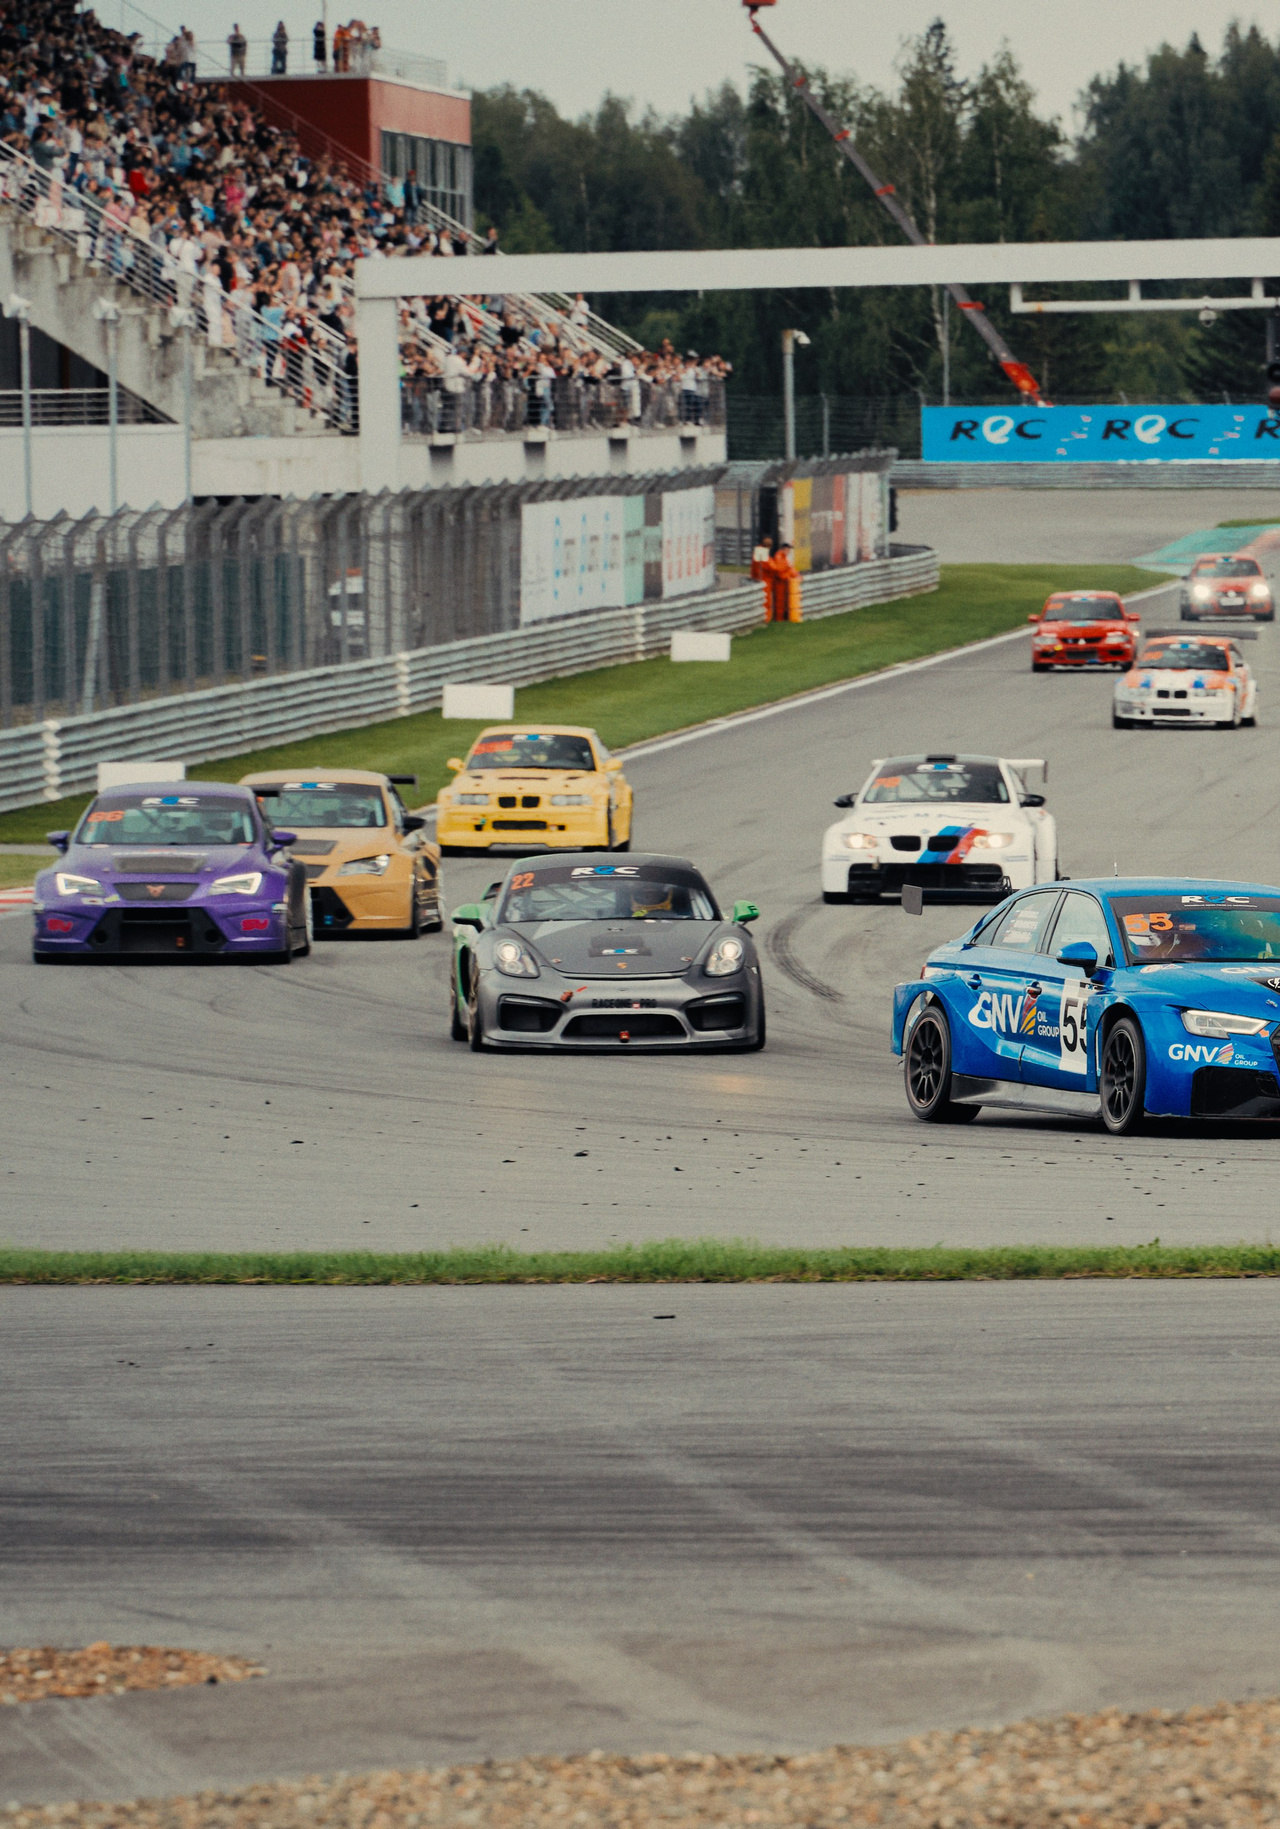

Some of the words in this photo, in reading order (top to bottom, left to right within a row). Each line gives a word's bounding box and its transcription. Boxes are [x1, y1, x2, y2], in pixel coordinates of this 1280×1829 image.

[511, 872, 535, 890] 22
[1123, 912, 1174, 933] 55
[1037, 1011, 1048, 1023] OIL
[1037, 1025, 1060, 1038] GROUP
[1168, 1043, 1220, 1063] GNV
[1234, 1059, 1259, 1067] GROUP
